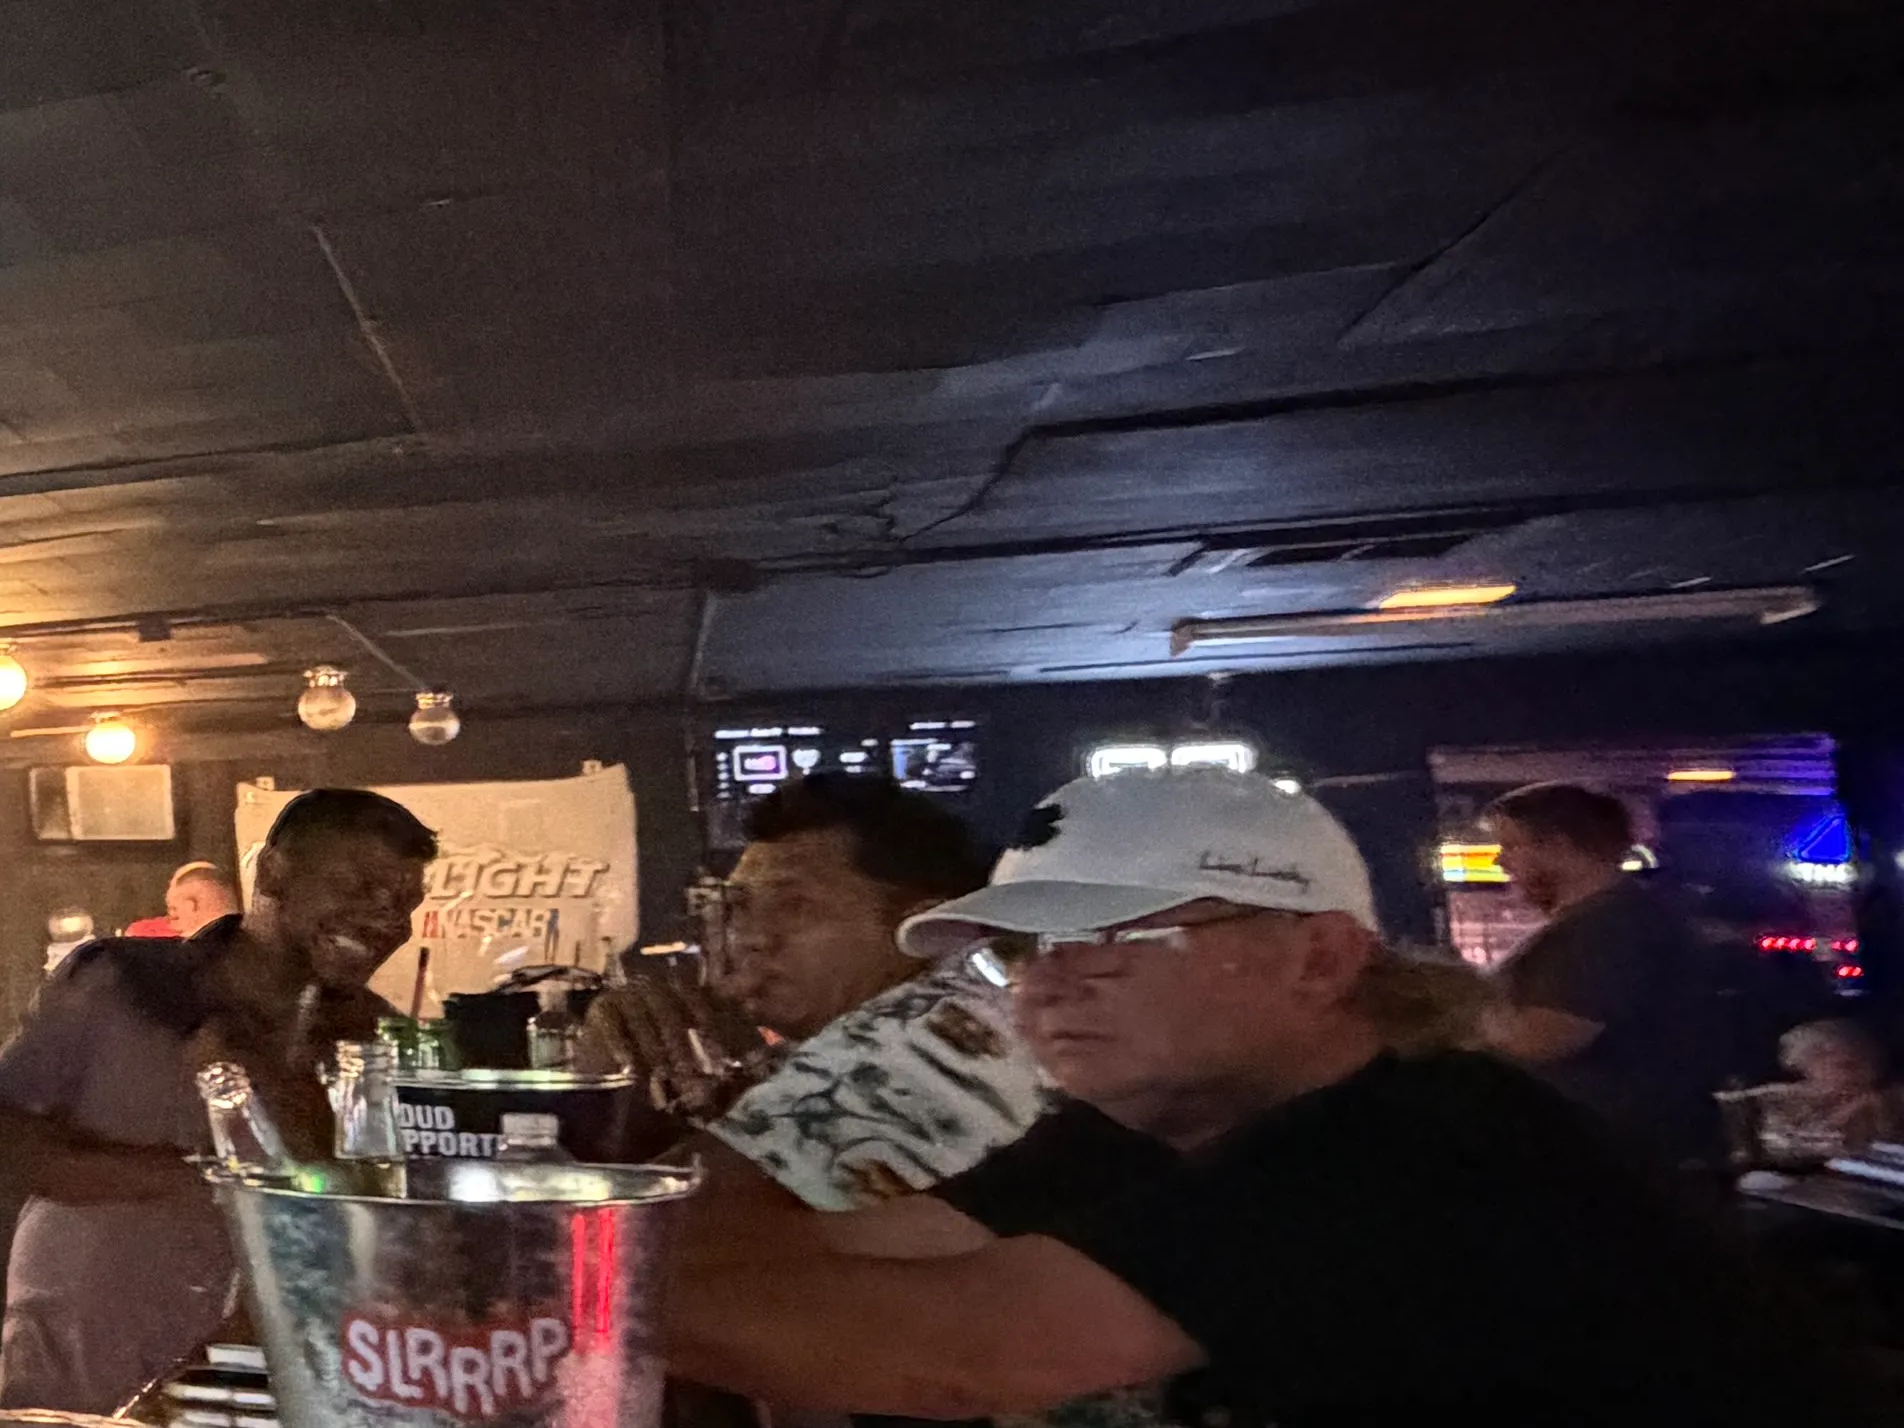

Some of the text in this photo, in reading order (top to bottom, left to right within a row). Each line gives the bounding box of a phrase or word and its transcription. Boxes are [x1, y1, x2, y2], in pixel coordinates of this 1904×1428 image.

[429, 855, 610, 900] LIGHT
[438, 908, 553, 939] NASCAR
[348, 1318, 569, 1416] SLRRRP
